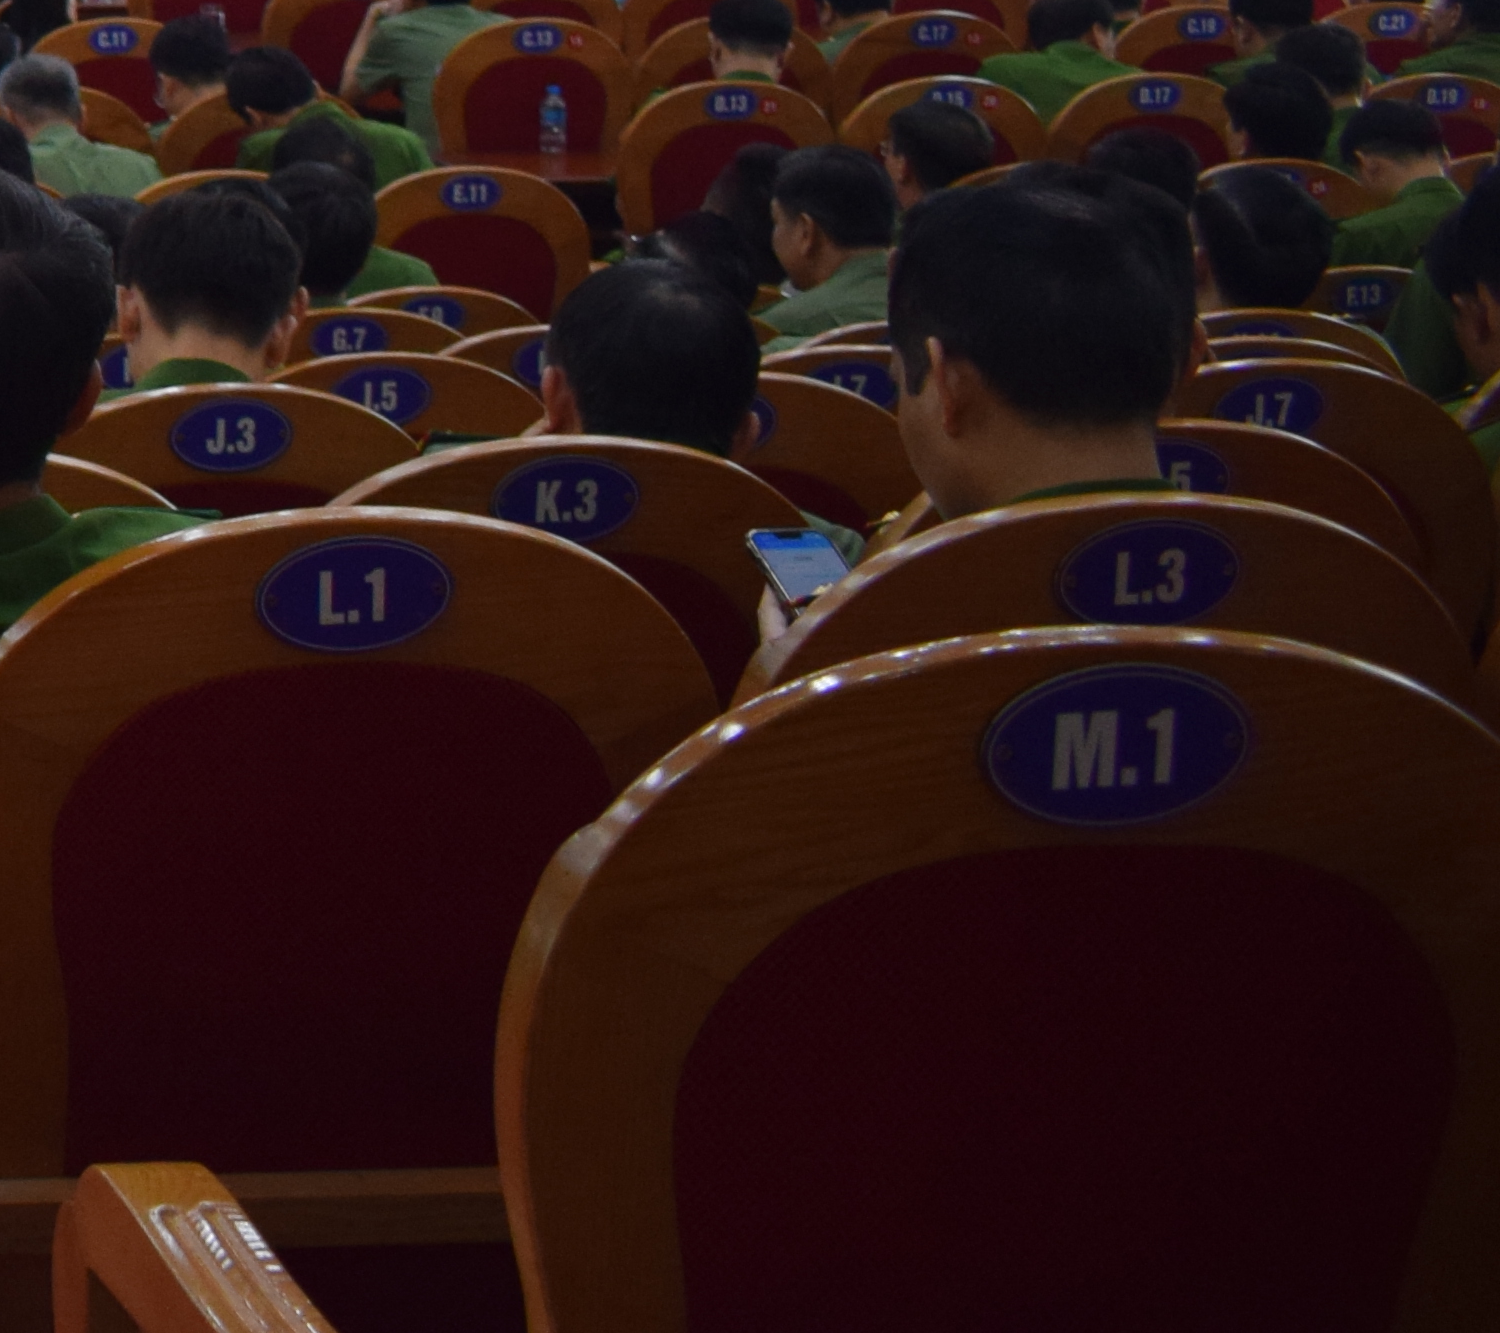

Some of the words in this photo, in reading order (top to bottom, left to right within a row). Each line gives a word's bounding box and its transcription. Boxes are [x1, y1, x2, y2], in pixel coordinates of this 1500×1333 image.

[453, 184, 486, 203] E.11
[207, 418, 255, 454] J.3
[535, 482, 597, 524] K.3
[319, 568, 385, 625] L.1
[1115, 549, 1185, 605] L.3
[1053, 710, 1174, 789] M.1
